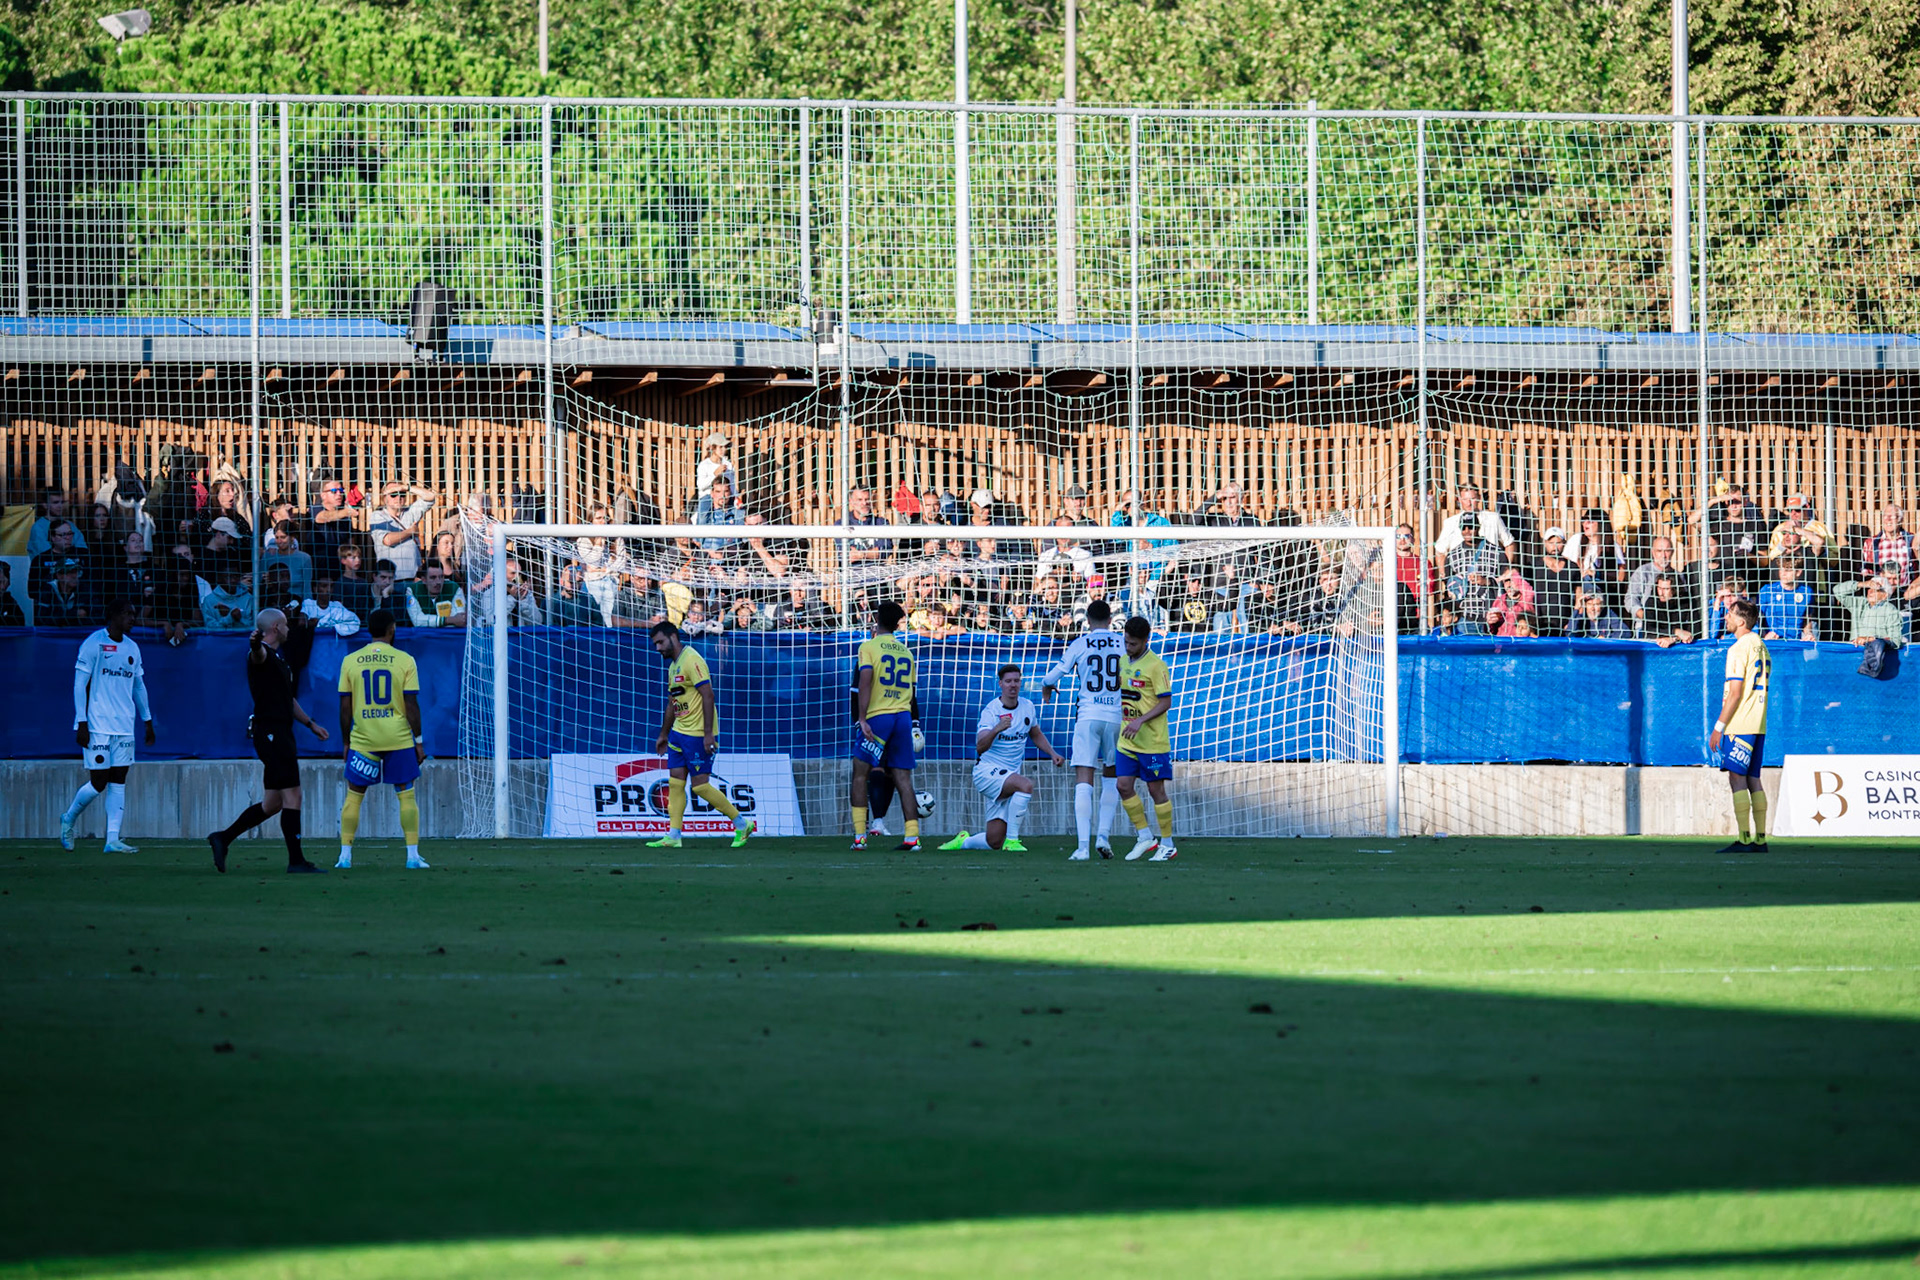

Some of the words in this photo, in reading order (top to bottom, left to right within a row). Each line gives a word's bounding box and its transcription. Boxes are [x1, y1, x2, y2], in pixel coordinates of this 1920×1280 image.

[1086, 637, 1120, 650] kpt:
[356, 654, 395, 664] OBRIST
[879, 654, 911, 689] 32
[1087, 654, 1121, 692] 39
[362, 669, 392, 705] 10
[1094, 697, 1114, 705] MALES
[350, 755, 379, 779] 2000
[1729, 746, 1751, 767] 200
